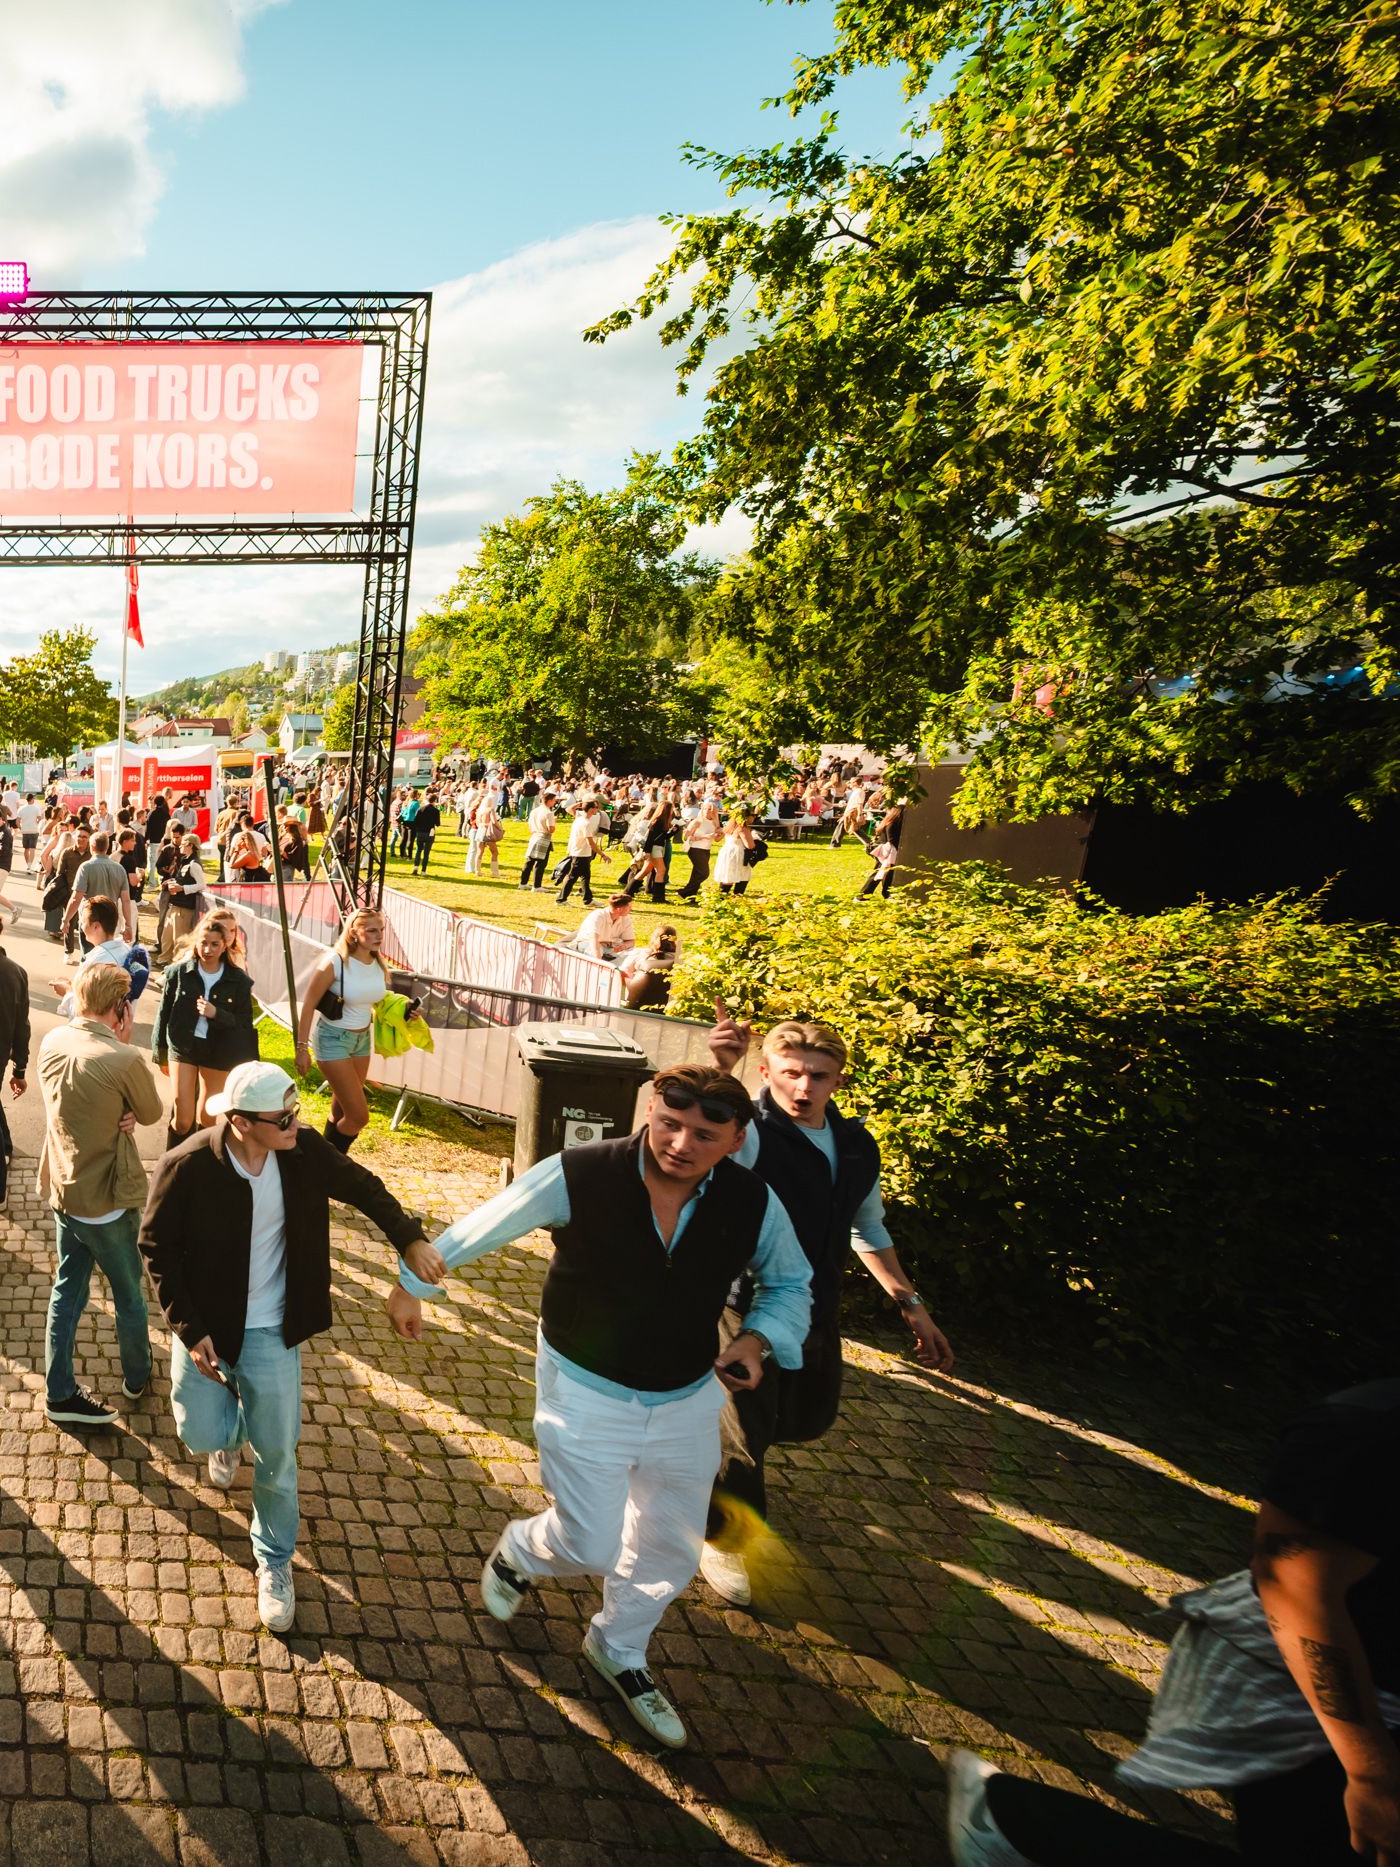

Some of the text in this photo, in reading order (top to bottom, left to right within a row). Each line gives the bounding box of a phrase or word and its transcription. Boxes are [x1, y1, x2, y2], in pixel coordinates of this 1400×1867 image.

[127, 363, 320, 422] TRUCKS
[133, 432, 274, 490] KORS.
[562, 1107, 586, 1119] NG
